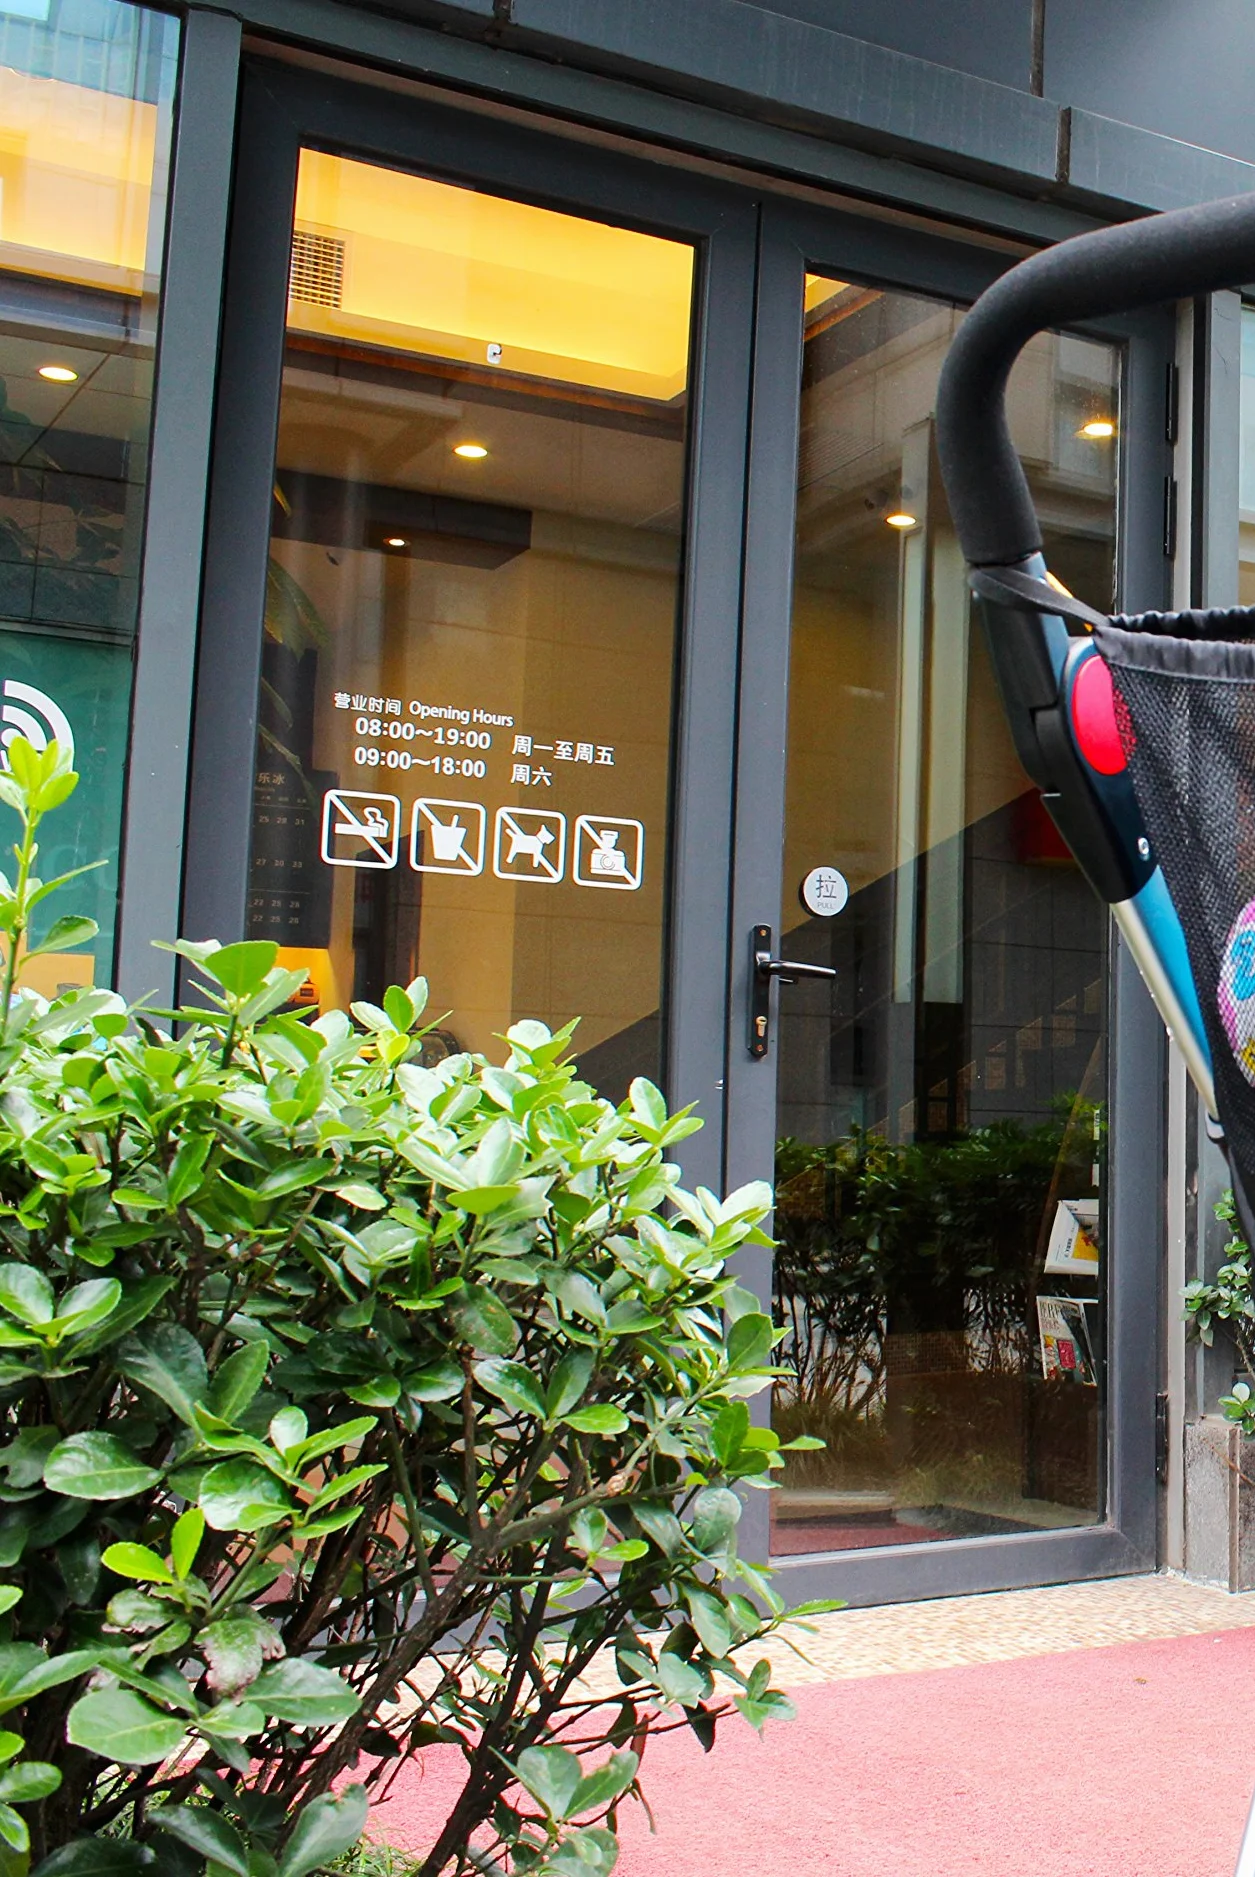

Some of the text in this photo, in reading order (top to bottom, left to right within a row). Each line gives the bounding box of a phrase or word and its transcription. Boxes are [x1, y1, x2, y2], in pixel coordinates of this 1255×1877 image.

[333, 692, 515, 728] 营业时间 Opening Hours
[512, 734, 615, 766] 周一至周五
[510, 763, 553, 787] 周六
[816, 875, 836, 898] 拉
